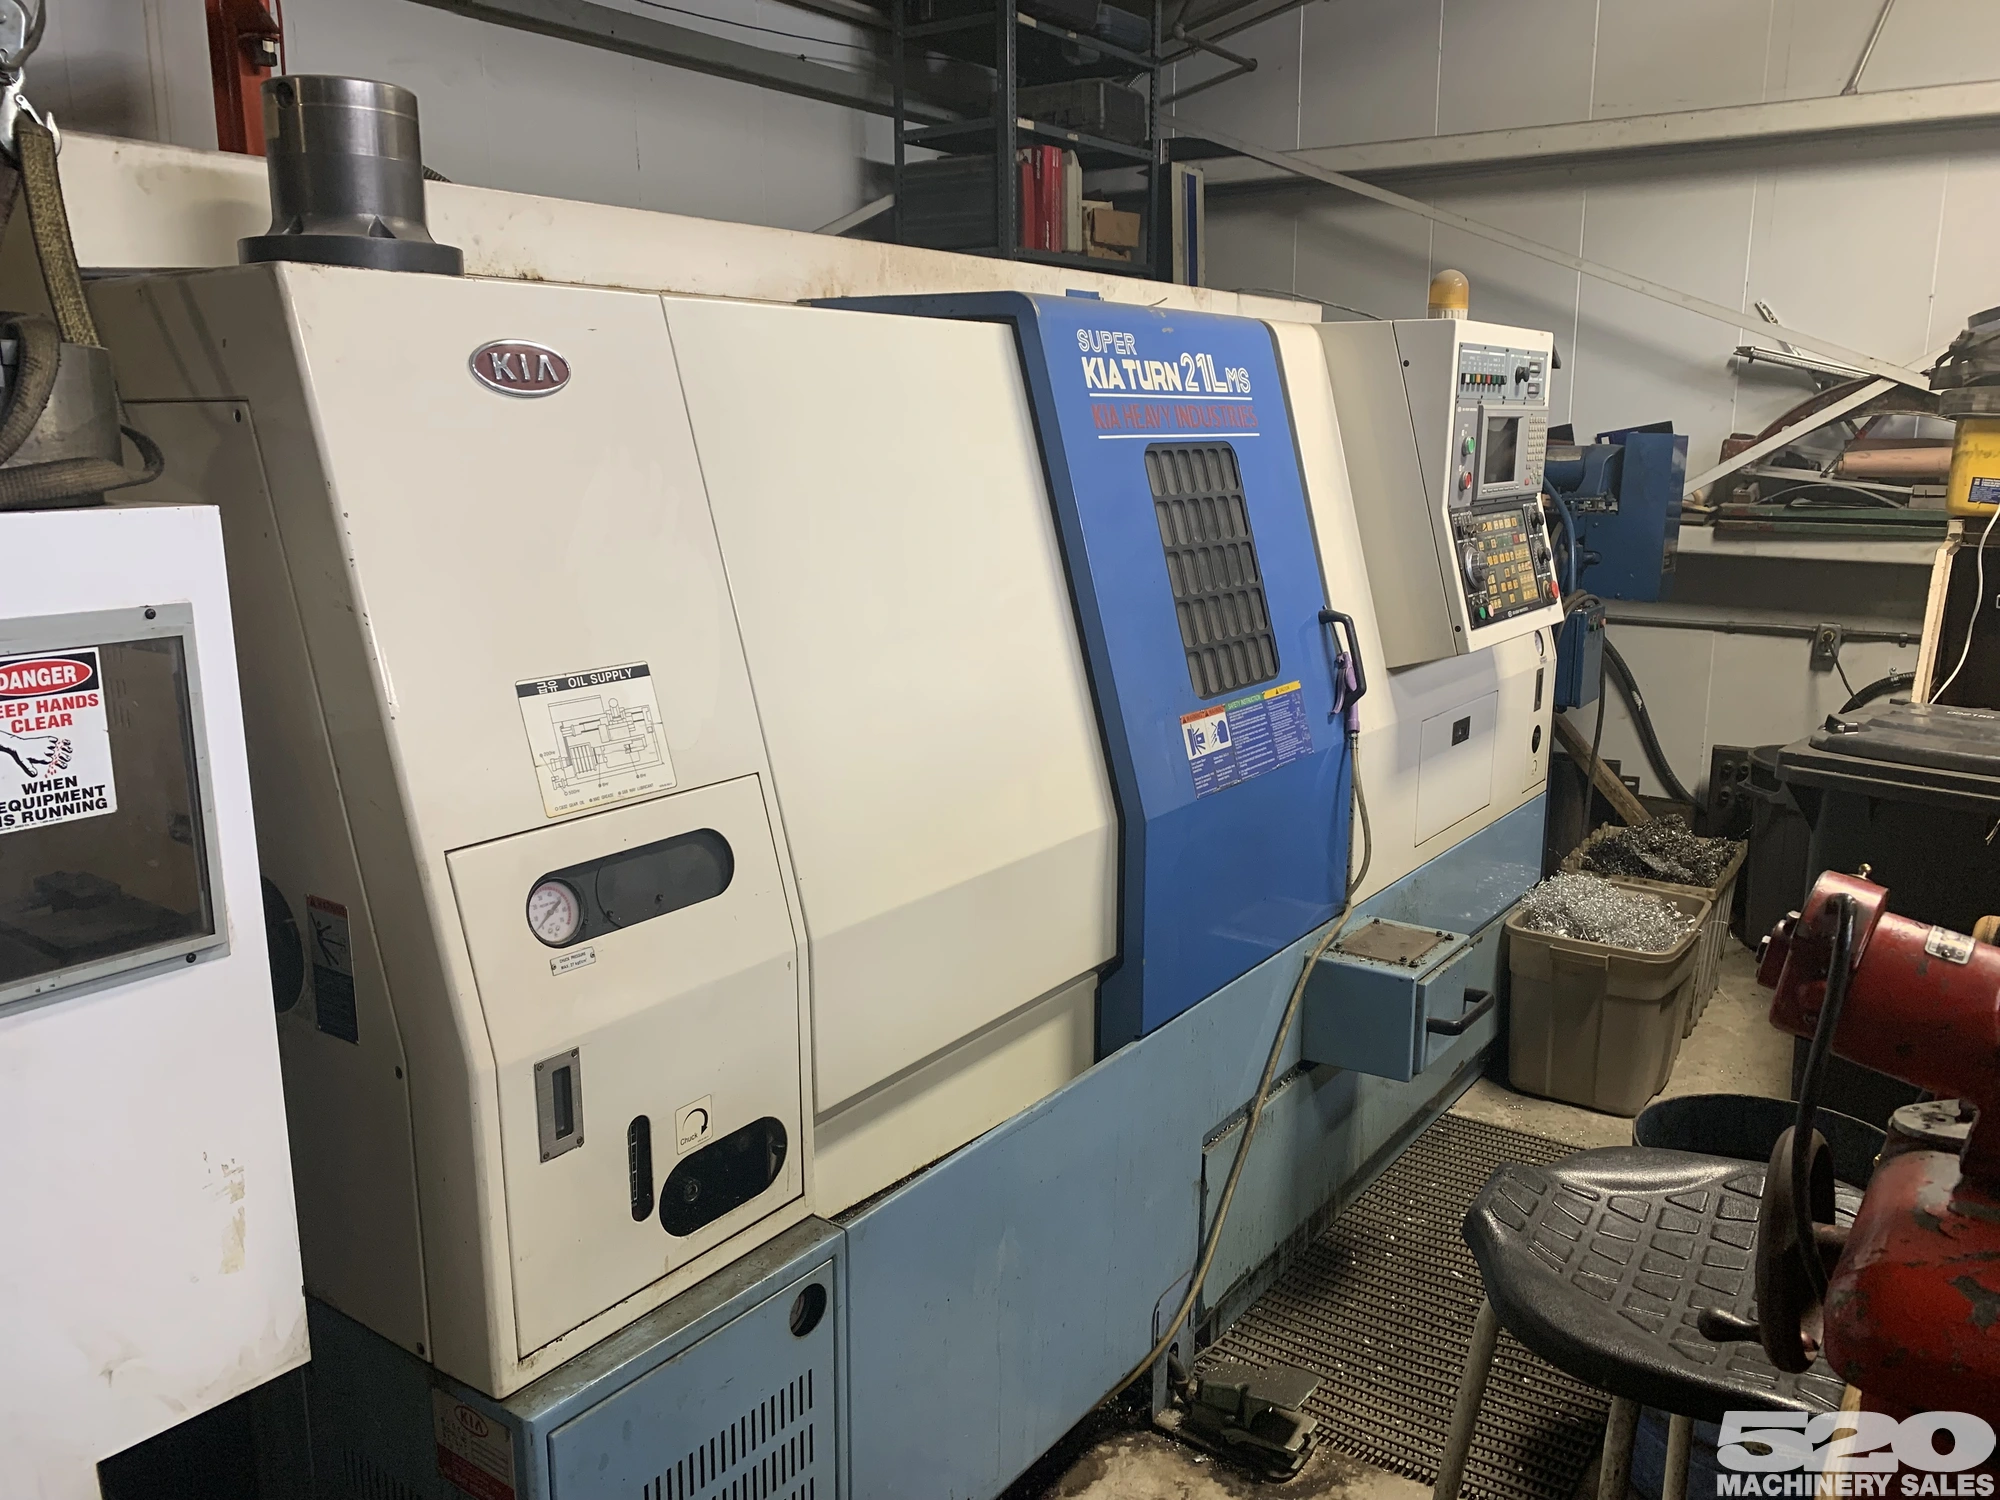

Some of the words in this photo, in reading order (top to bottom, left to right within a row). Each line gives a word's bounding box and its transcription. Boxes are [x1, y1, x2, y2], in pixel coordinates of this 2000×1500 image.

[1076, 328, 1137, 355] SUPER
[491, 352, 560, 382] KIA
[1091, 403, 1121, 429] KIA
[1121, 404, 1171, 429] HEAVY
[1174, 404, 1259, 429] INDUSTRIES
[536, 680, 559, 695] 급유
[567, 675, 588, 689] OIL
[591, 668, 633, 684] SUPPLY
[36, 693, 99, 714] HANDS
[11, 713, 73, 734] CLEAR
[21, 775, 78, 796] WHEN
[21, 797, 108, 823] RUNNING
[680, 1133, 698, 1146] Chuck
